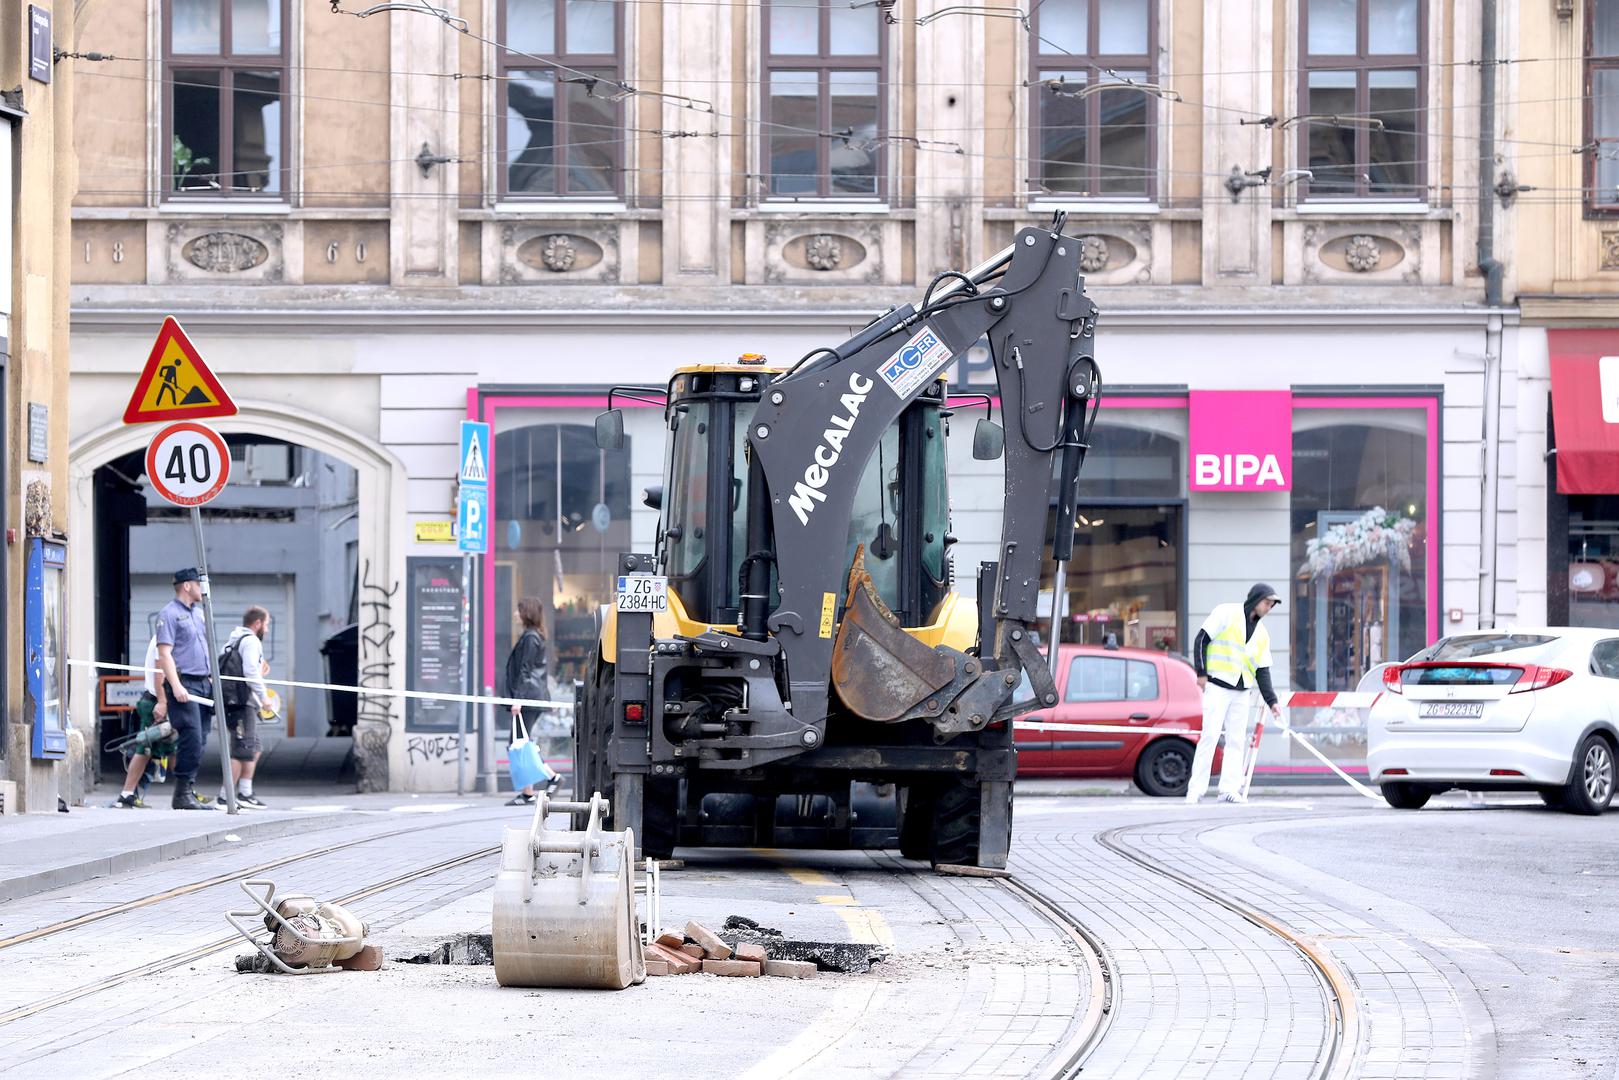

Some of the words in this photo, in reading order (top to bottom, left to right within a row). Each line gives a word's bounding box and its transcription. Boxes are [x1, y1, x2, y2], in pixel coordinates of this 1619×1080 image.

[885, 335, 936, 382] LAGER
[165, 443, 211, 484] 40
[1195, 454, 1285, 486] BIPA
[465, 499, 481, 539] P
[634, 579, 652, 594] ZG
[1426, 703, 1439, 716] ZG
